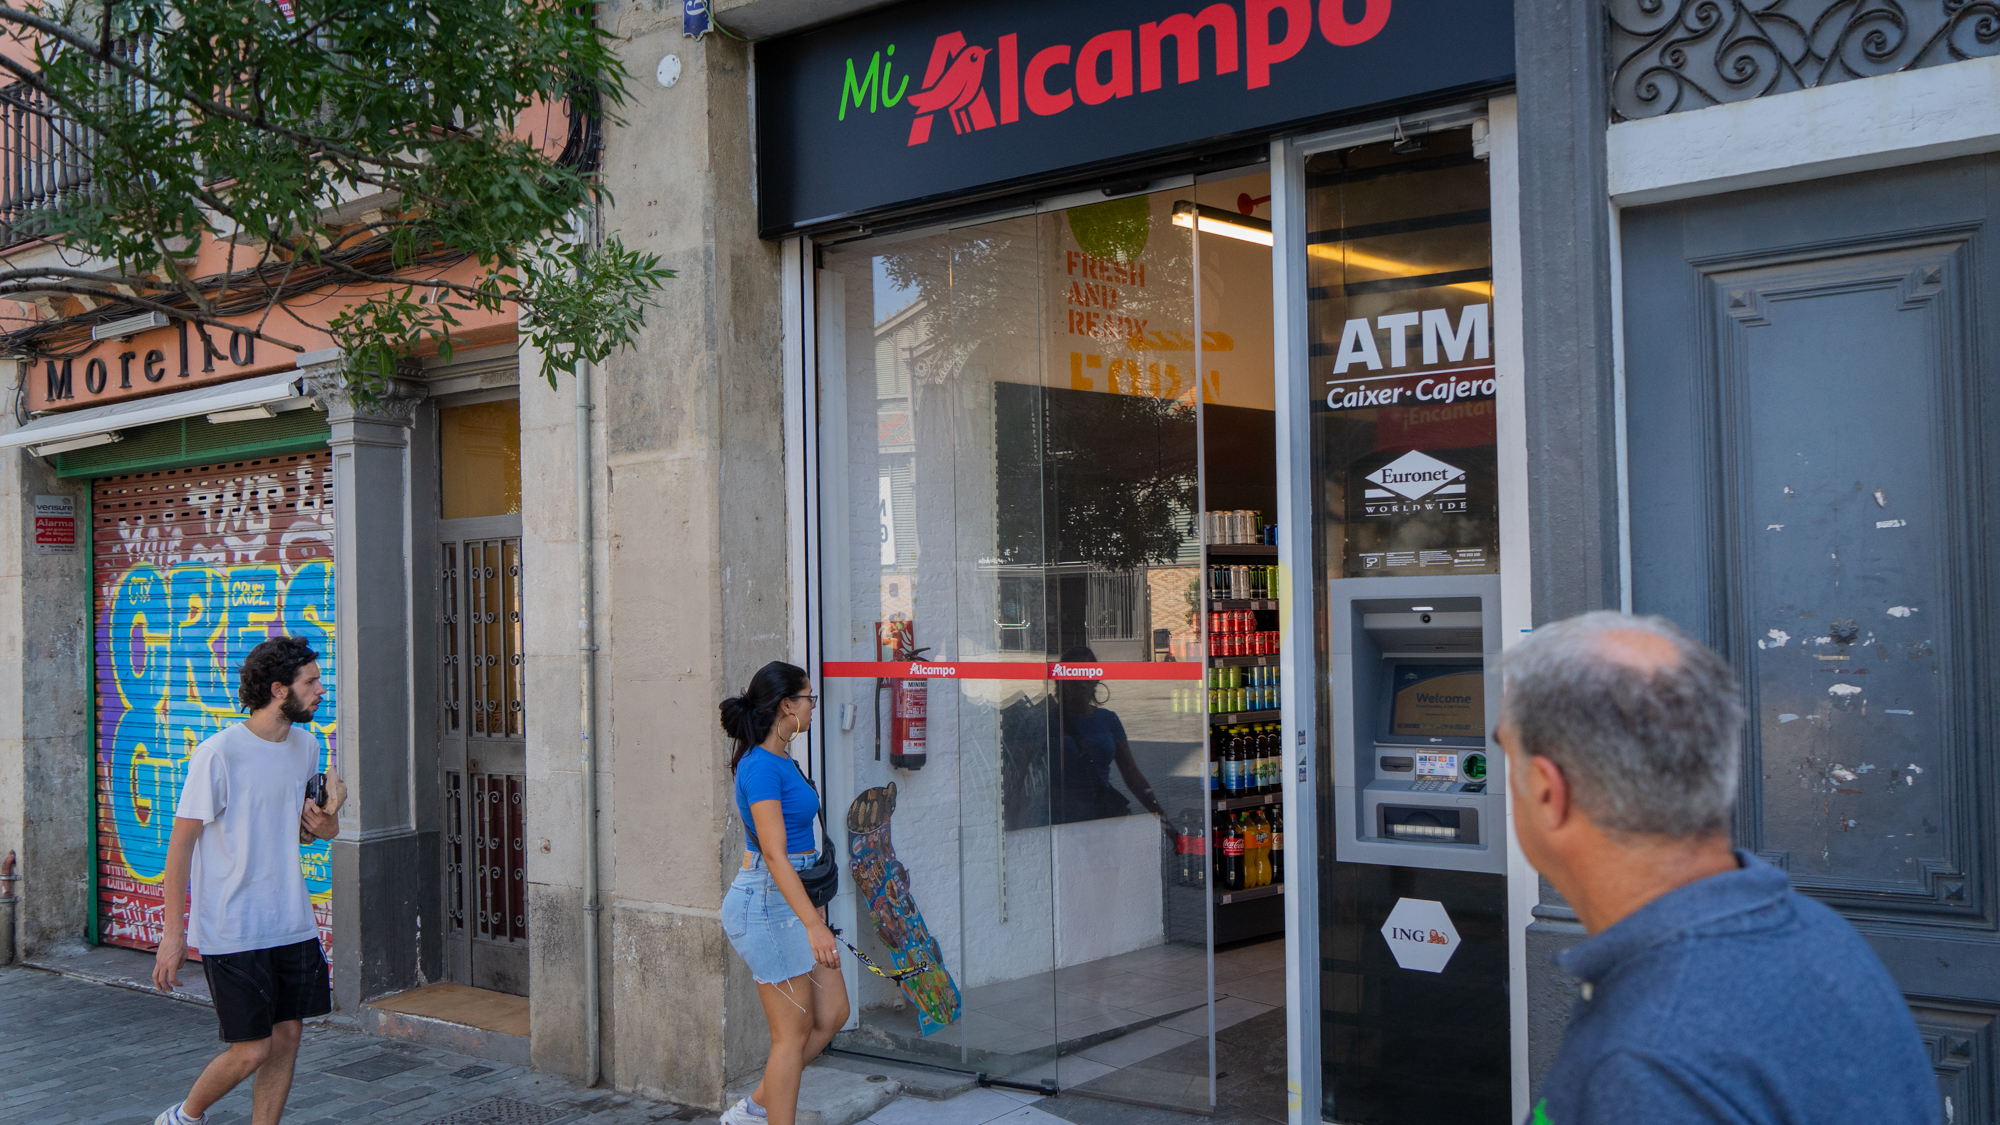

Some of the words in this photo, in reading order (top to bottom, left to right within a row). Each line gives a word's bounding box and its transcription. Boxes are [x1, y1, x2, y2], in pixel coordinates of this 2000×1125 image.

[837, 44, 909, 121] Mi
[907, 0, 1392, 147] Alcampo
[1066, 250, 1145, 287] FRESH
[1068, 281, 1117, 311] AND
[1068, 308, 1147, 343] READY
[1333, 303, 1490, 375] ATM
[1381, 468, 1448, 484] Euronet
[1365, 502, 1467, 514] WORLDWIDE
[37, 519, 74, 527] Alarma
[909, 662, 956, 677] Alcampo
[1052, 663, 1103, 678] Alcampo
[1416, 693, 1472, 704] Welcome
[1391, 926, 1425, 942] ING
